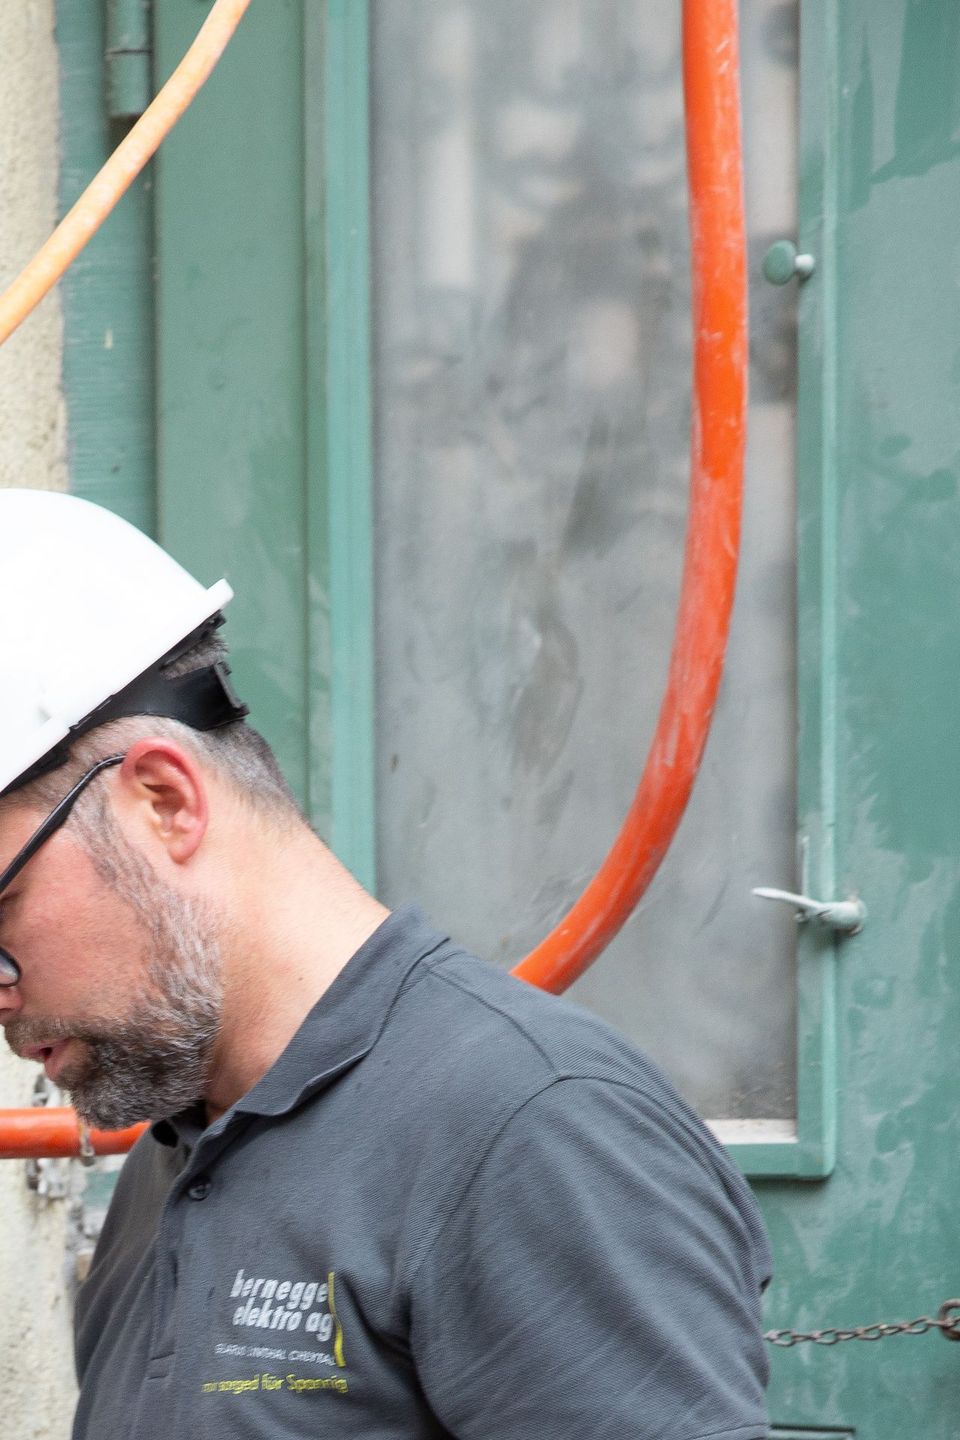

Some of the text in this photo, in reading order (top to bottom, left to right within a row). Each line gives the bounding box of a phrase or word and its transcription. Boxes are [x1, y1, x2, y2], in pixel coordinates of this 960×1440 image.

[232, 1297, 334, 1342] elektro ag
[261, 1373, 285, 1391] für
